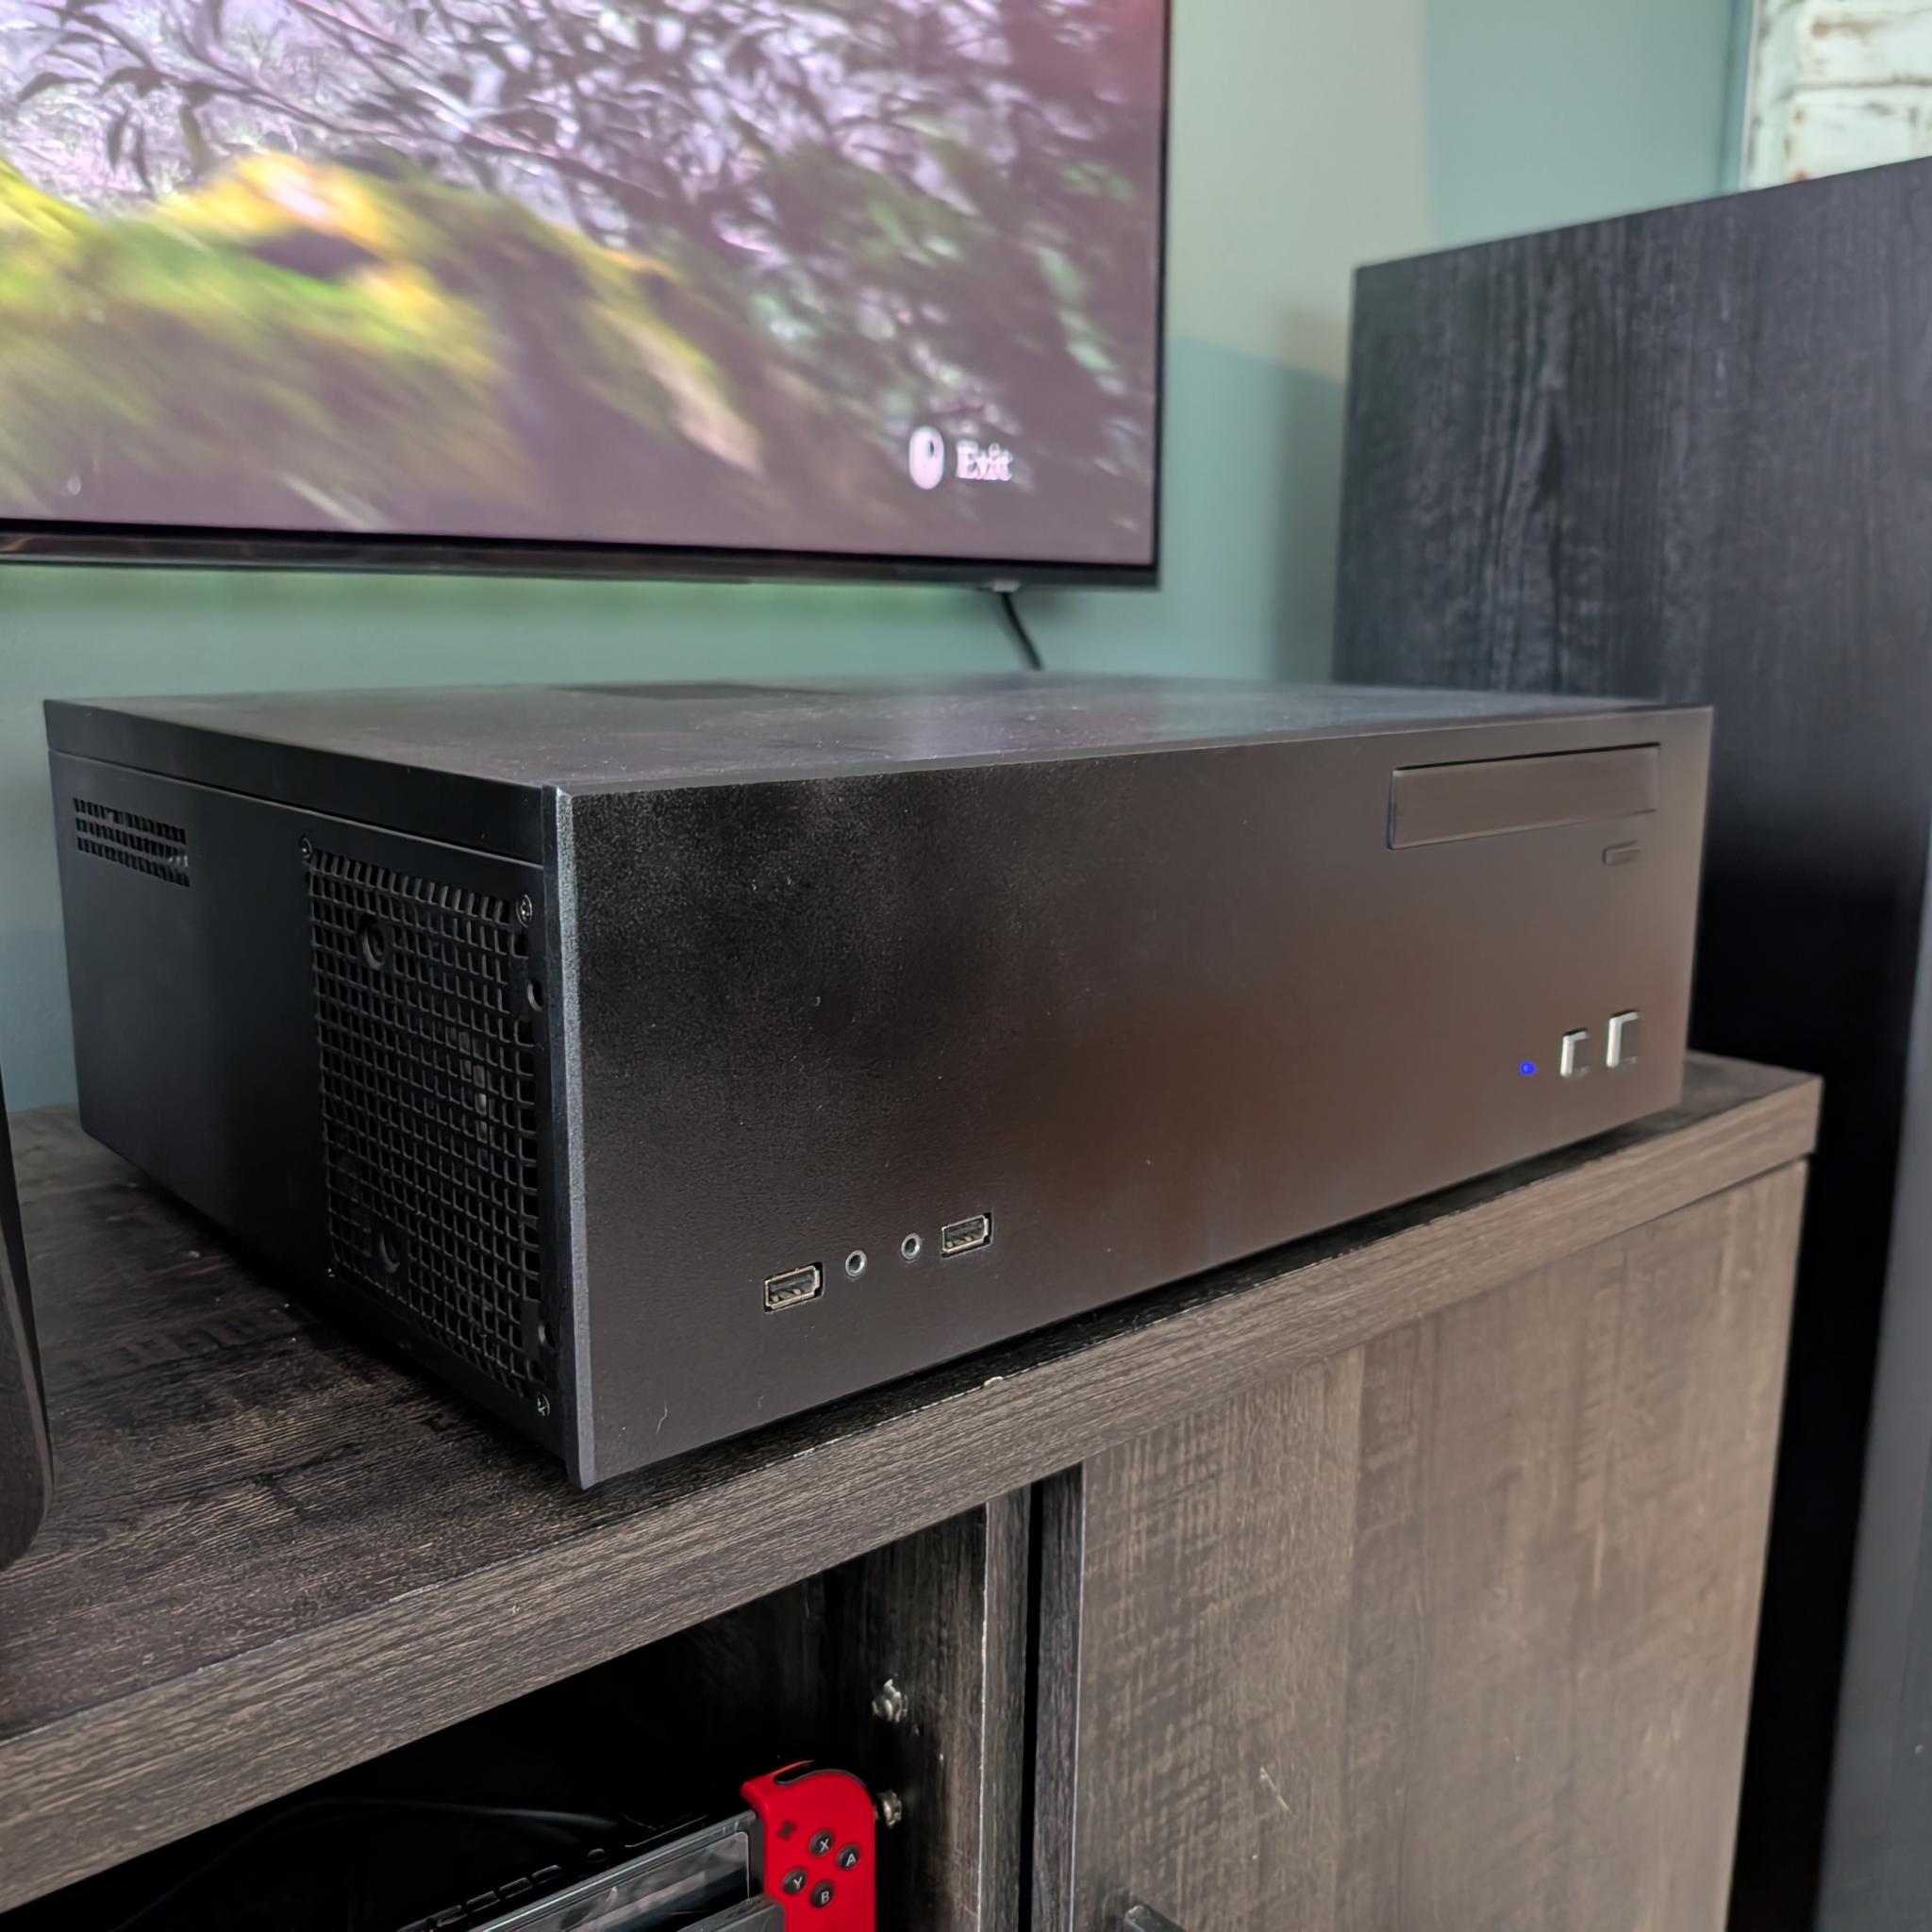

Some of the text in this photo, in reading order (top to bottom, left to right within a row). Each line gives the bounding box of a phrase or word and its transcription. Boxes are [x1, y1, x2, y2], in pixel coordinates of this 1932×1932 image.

[957, 440, 1013, 481] Exit
[819, 1838, 829, 1854] X
[845, 1854, 857, 1867] A
[793, 1876, 803, 1890] Y
[821, 1890, 830, 1904] B
